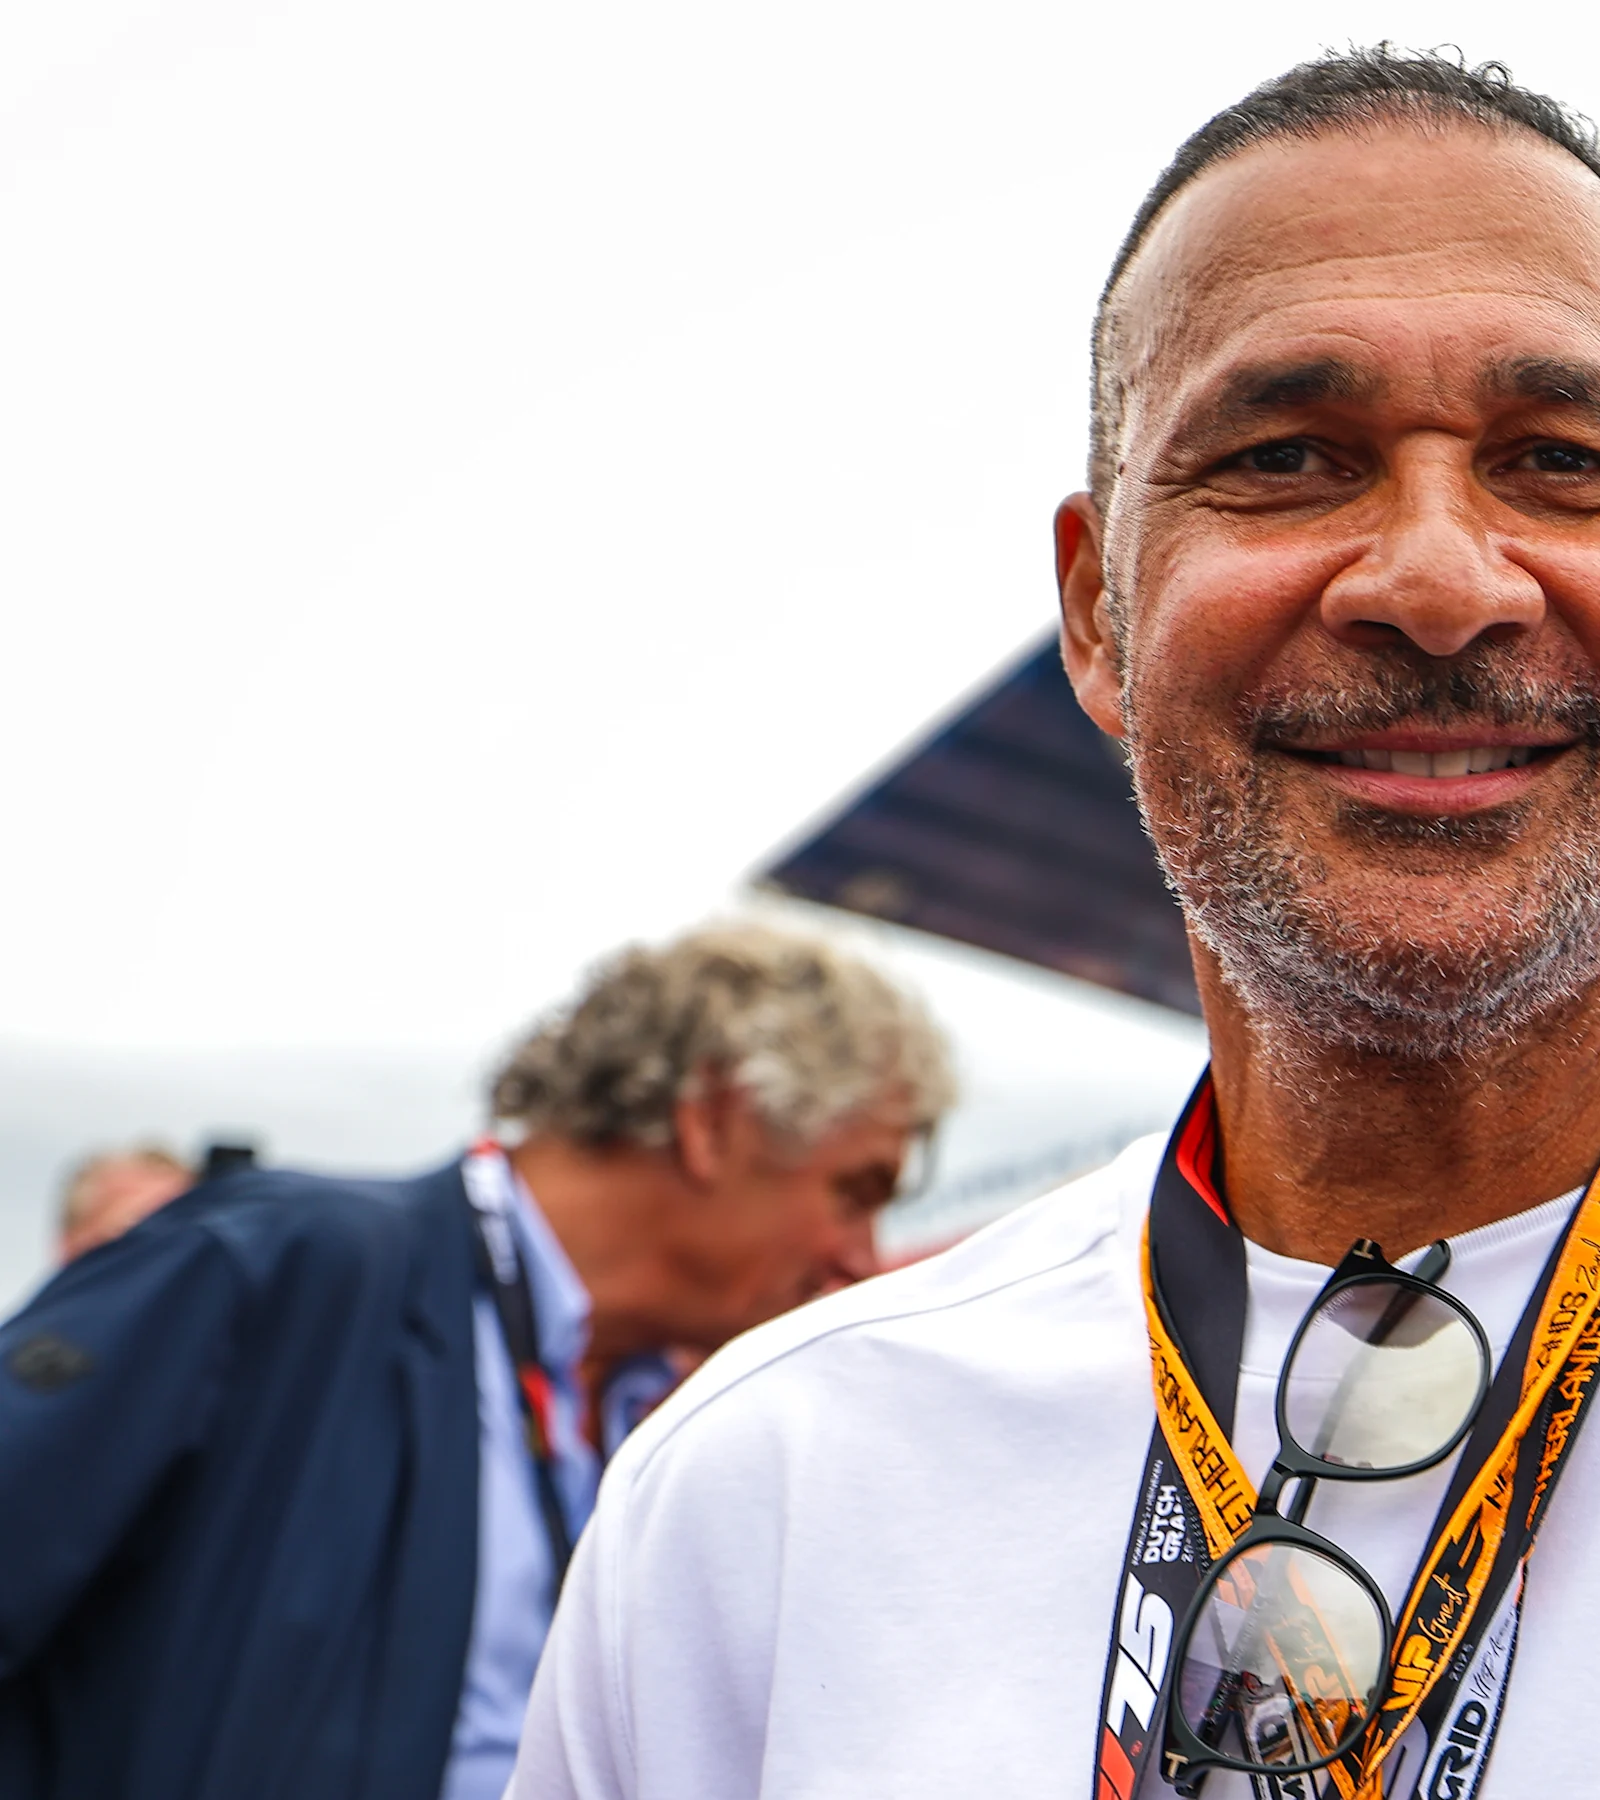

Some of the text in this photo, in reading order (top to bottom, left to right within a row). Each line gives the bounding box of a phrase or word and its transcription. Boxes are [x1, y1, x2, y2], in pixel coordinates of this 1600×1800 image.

[1157, 1355, 1254, 1540] ETHERLANDS
[1142, 1485, 1178, 1564] DUTCH
[1161, 1495, 1186, 1563] GRA
[1381, 1572, 1468, 1711] VIP Guest
